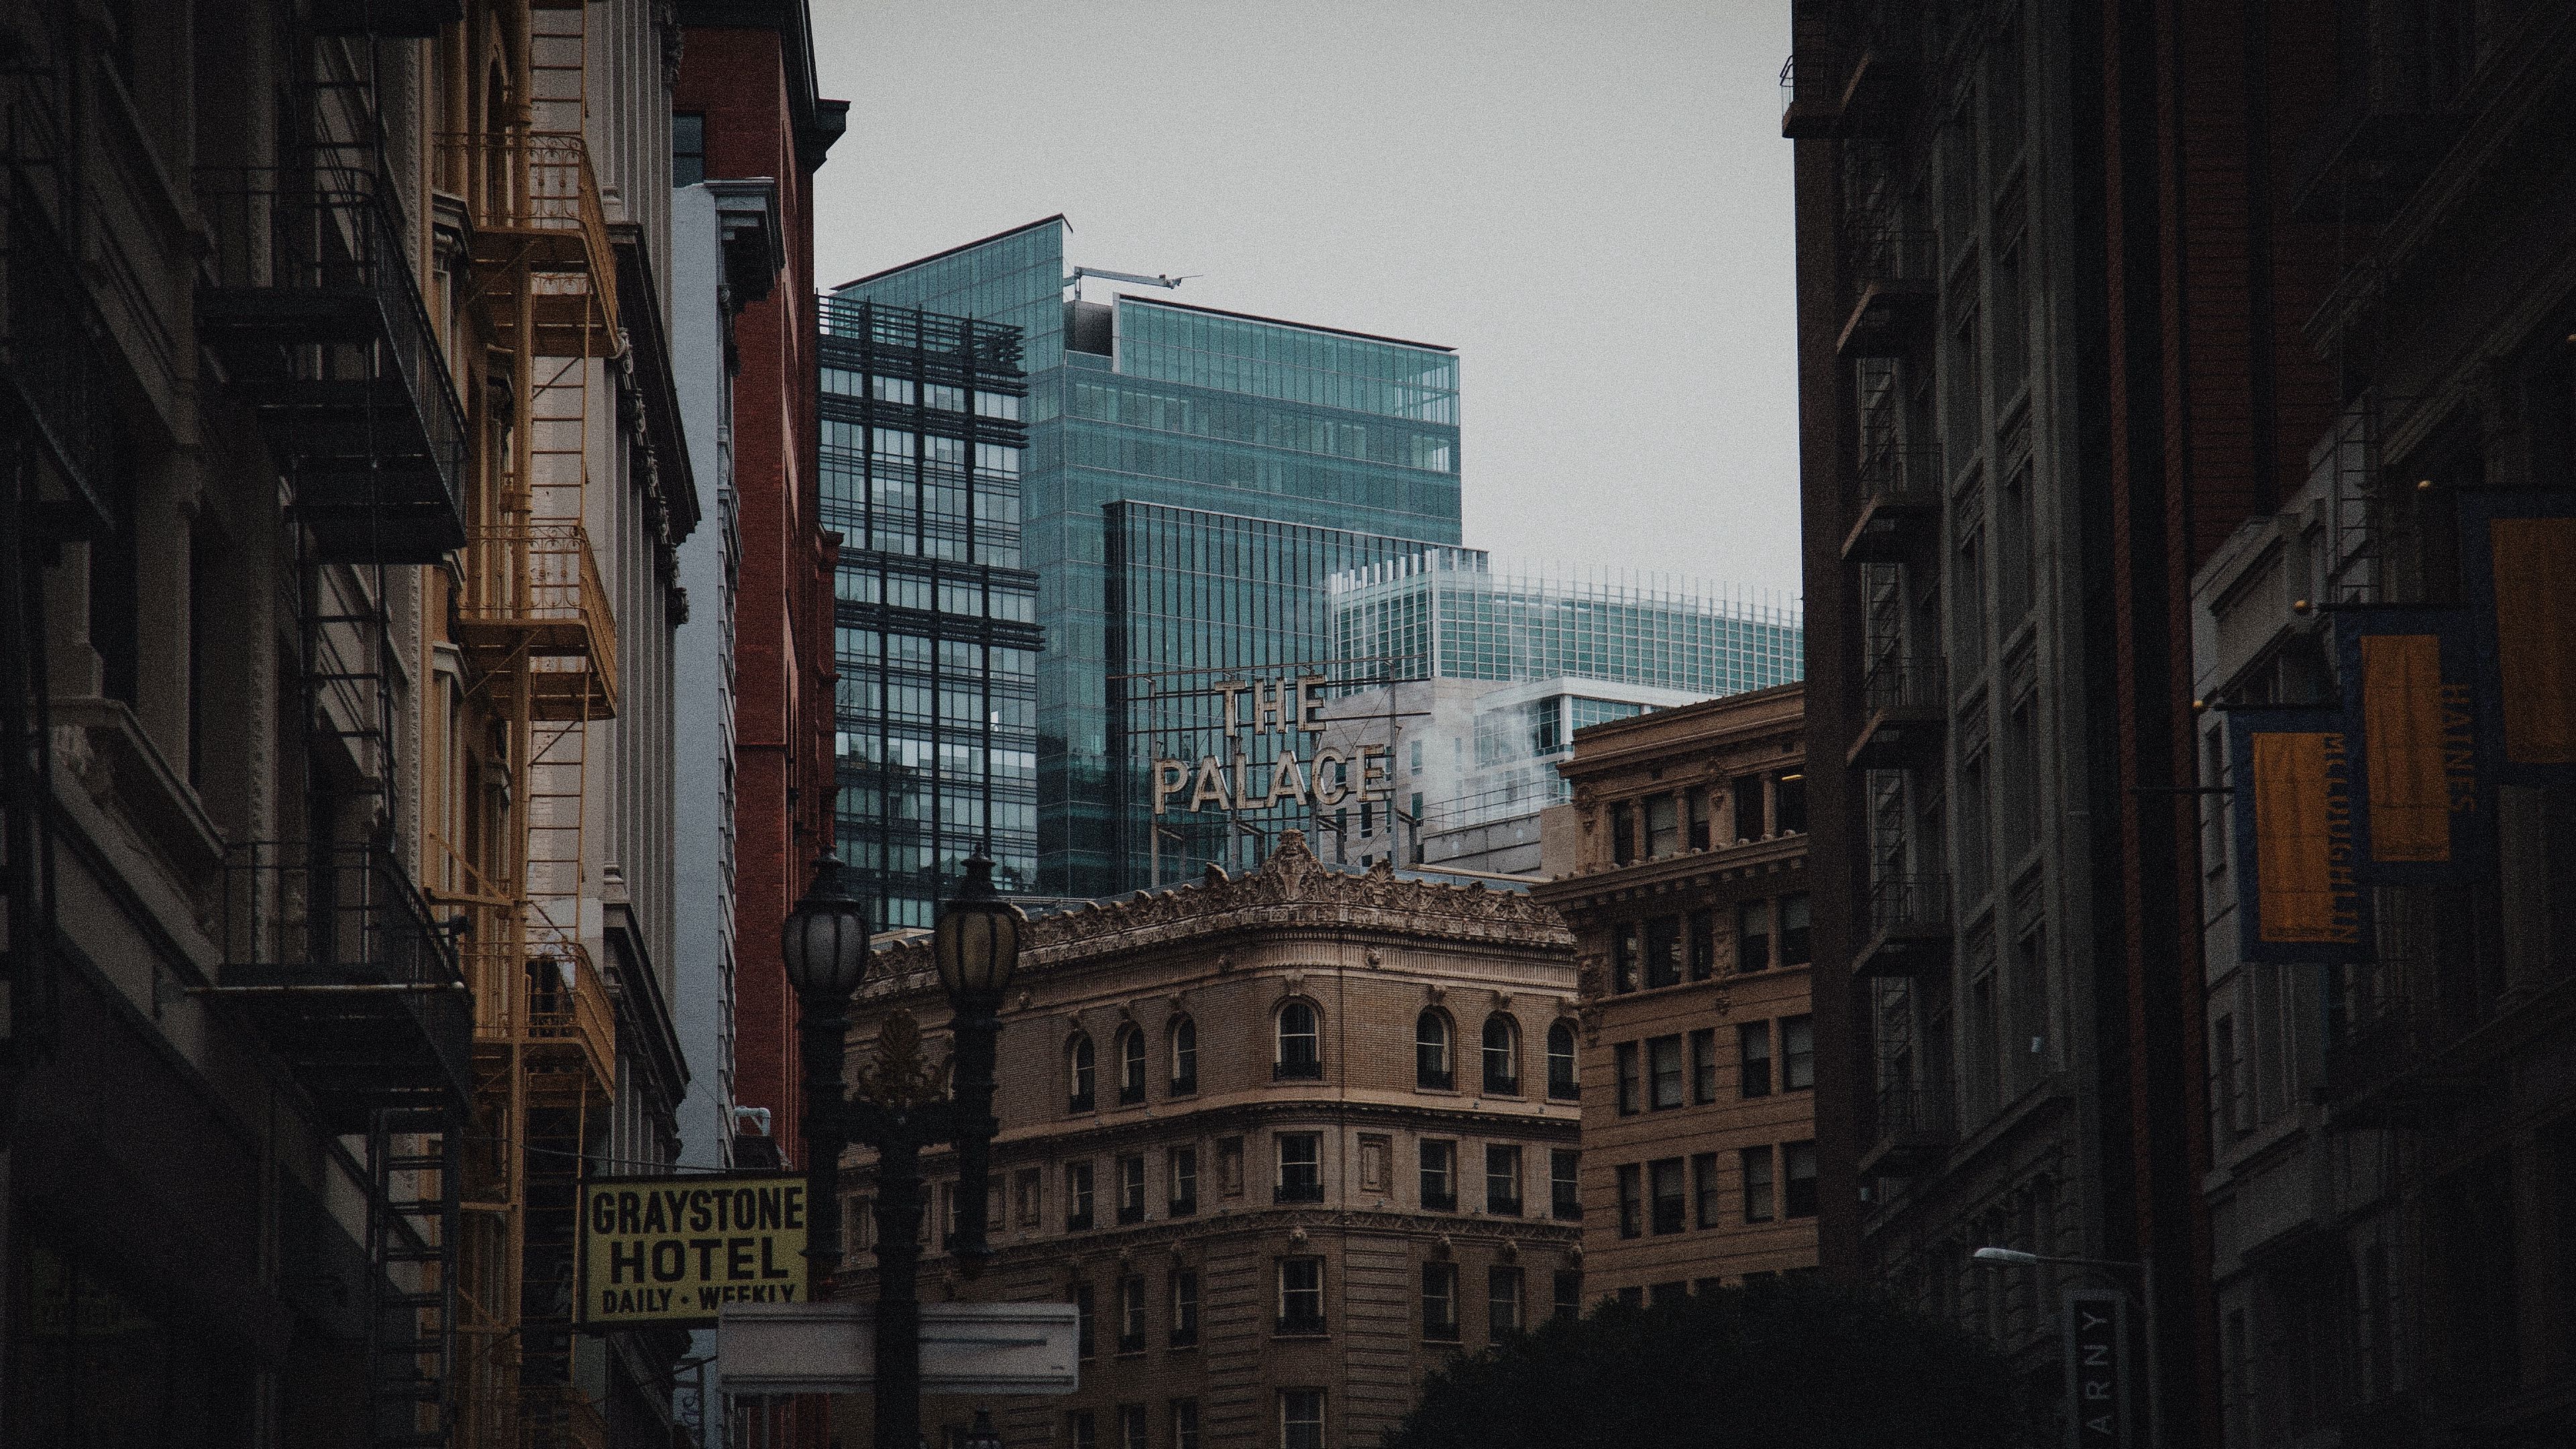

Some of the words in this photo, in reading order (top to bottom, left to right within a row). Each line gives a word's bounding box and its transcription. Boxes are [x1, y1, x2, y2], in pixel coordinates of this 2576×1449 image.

[1215, 674, 1327, 737] THE
[1154, 743, 1393, 815] PALACE
[2440, 682, 2477, 814] HAINES
[2323, 732, 2359, 943] MCLOUGHLIN
[592, 1186, 803, 1234] GRAYSTONE
[610, 1237, 788, 1283] HOTEL
[603, 1288, 672, 1313] DAILY
[698, 1284, 795, 1310] WEEKLY
[2081, 1310, 2113, 1436] ARNY
